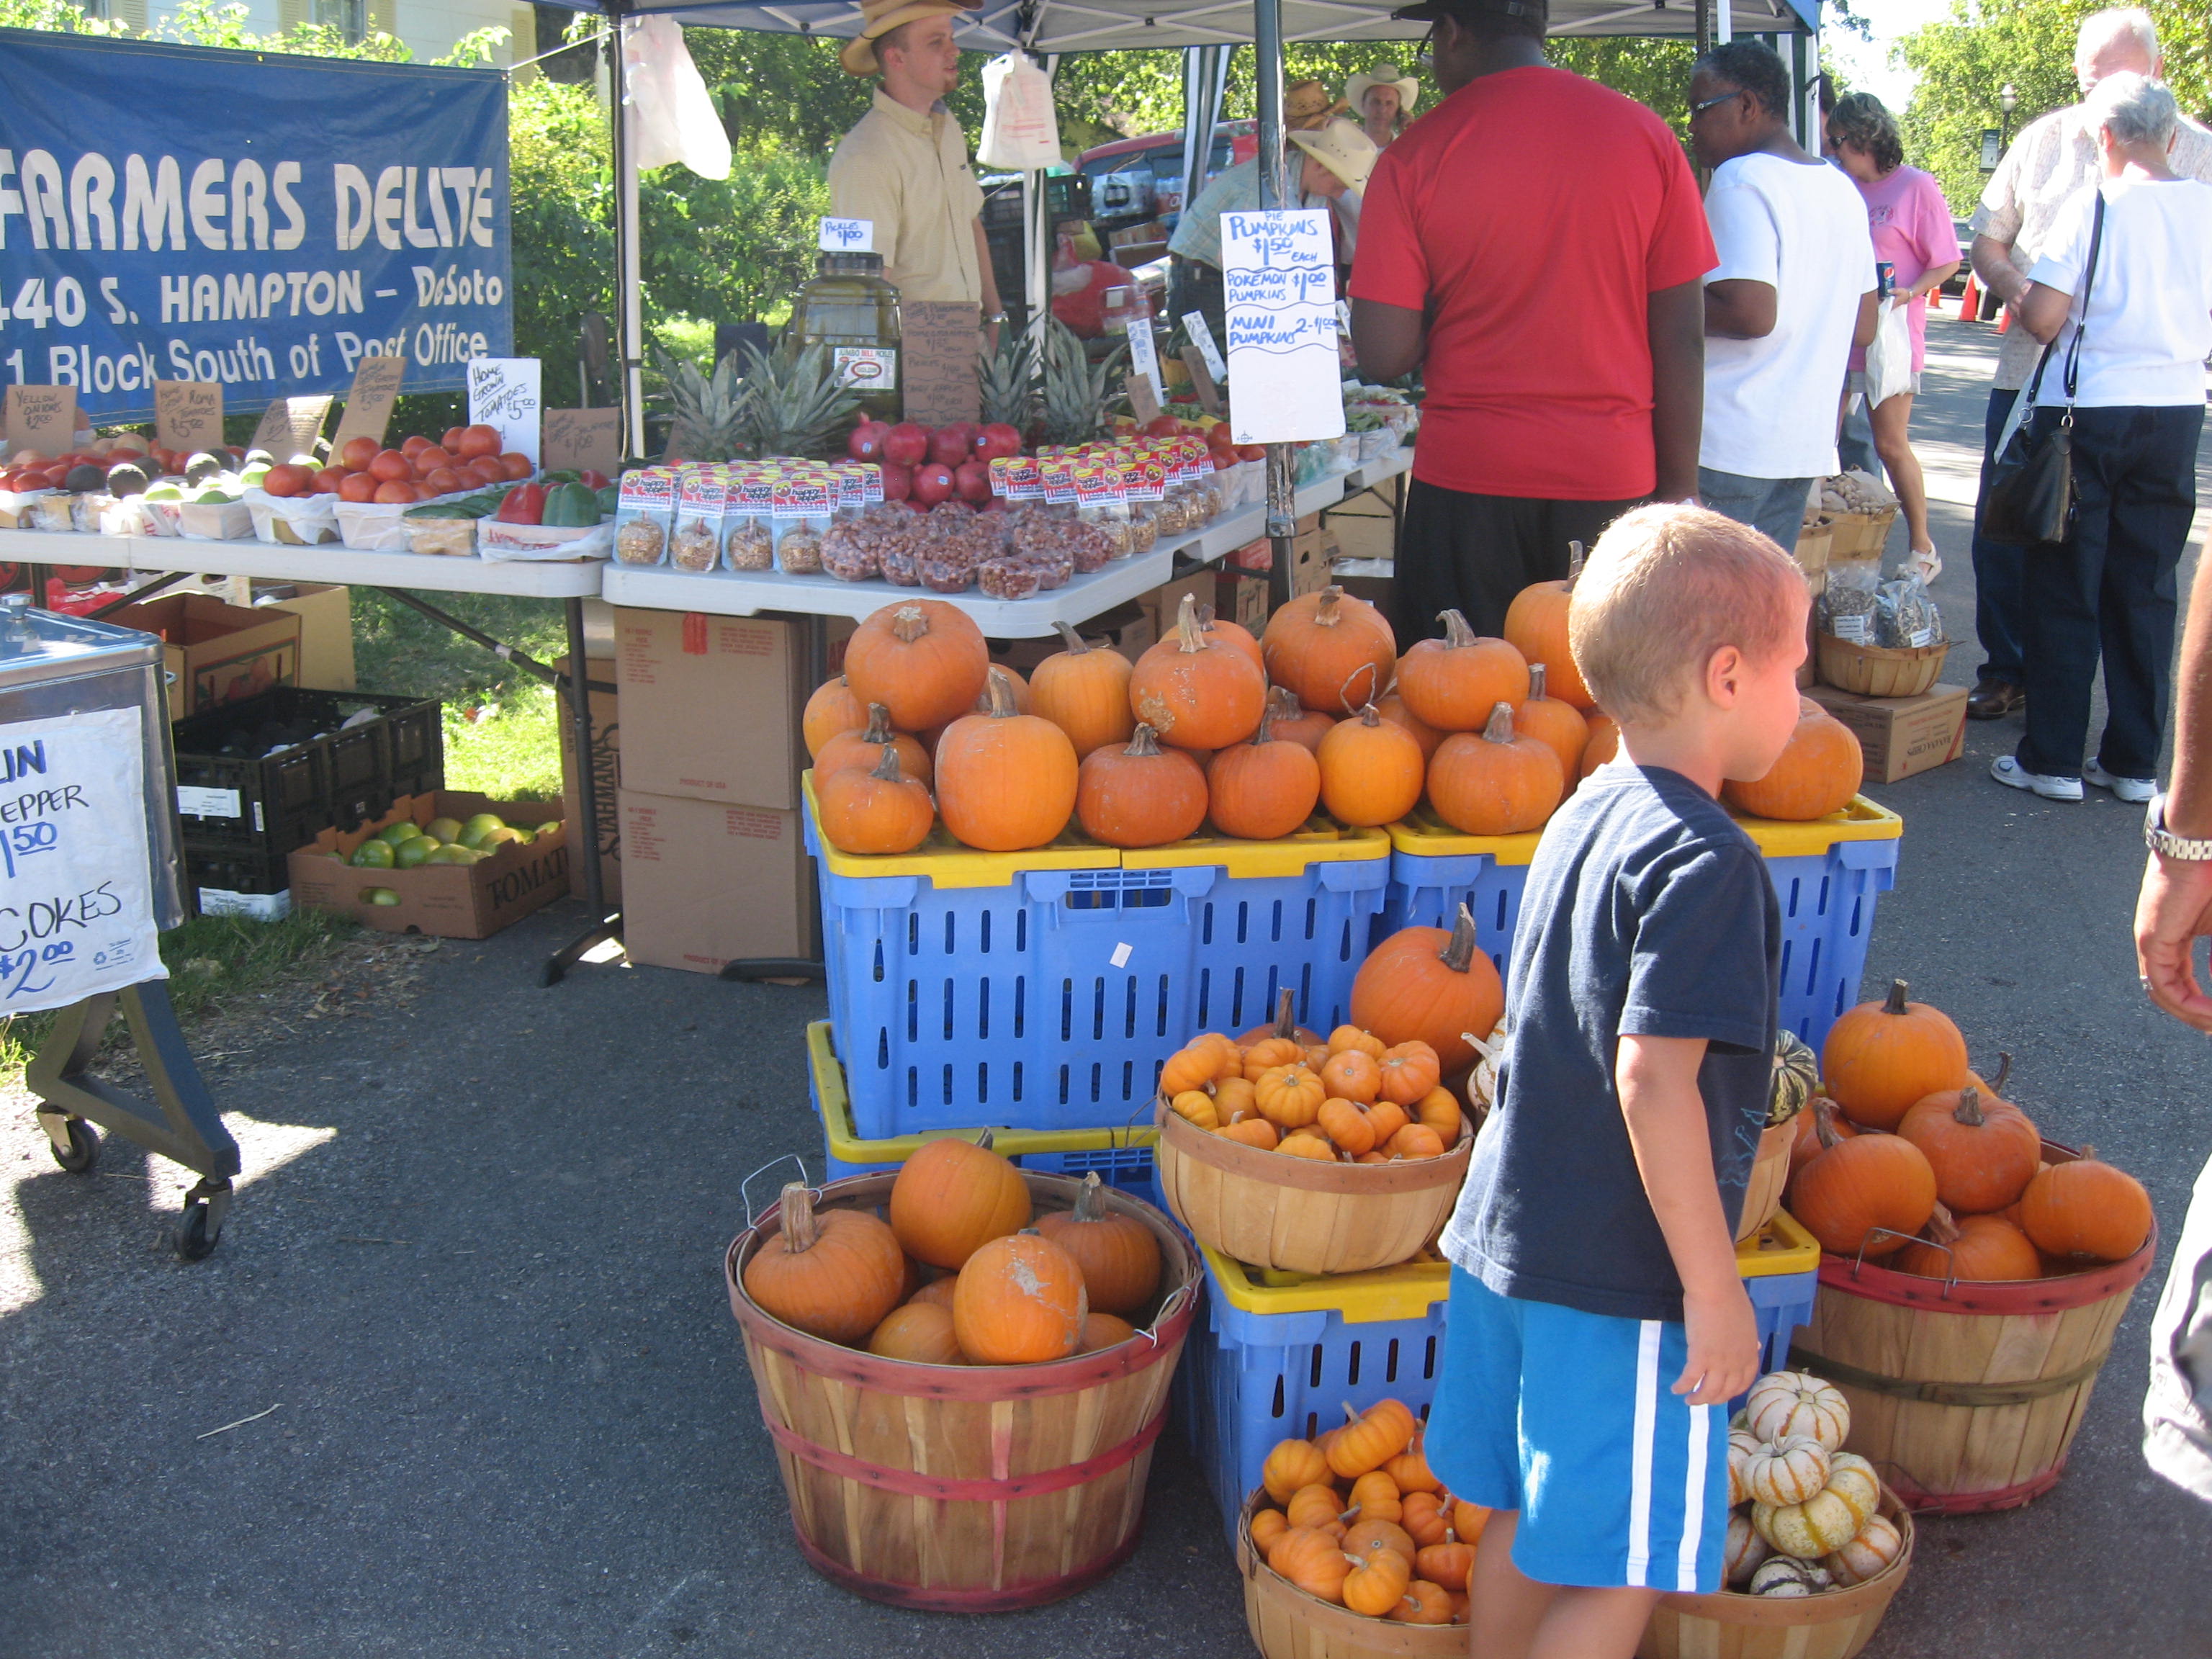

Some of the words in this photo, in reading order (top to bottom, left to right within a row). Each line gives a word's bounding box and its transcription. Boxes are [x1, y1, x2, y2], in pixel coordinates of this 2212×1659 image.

[0, 149, 306, 252] FARMERS
[334, 163, 493, 251] DELITE
[1228, 215, 1318, 240] PUMPKINS
[1264, 211, 1284, 221] PIE
[1291, 251, 1318, 263] EACH
[1226, 273, 1287, 287] POKEMON
[0, 276, 87, 331] 40
[101, 276, 139, 325] S.
[161, 269, 364, 323] HAMPTON
[411, 264, 503, 307] DeSoto
[1228, 288, 1286, 302] PUMPKINS
[1230, 315, 1275, 330] MINI
[1230, 331, 1296, 346] PUMPKINS
[6, 349, 24, 385] 1
[50, 341, 158, 394] Block
[169, 336, 276, 384] South
[289, 333, 321, 379] of
[335, 328, 406, 373] Post
[415, 323, 489, 367] Office
[472, 364, 502, 387] HOME
[474, 382, 528, 422] TOMATOES
[0, 739, 47, 783] IN
